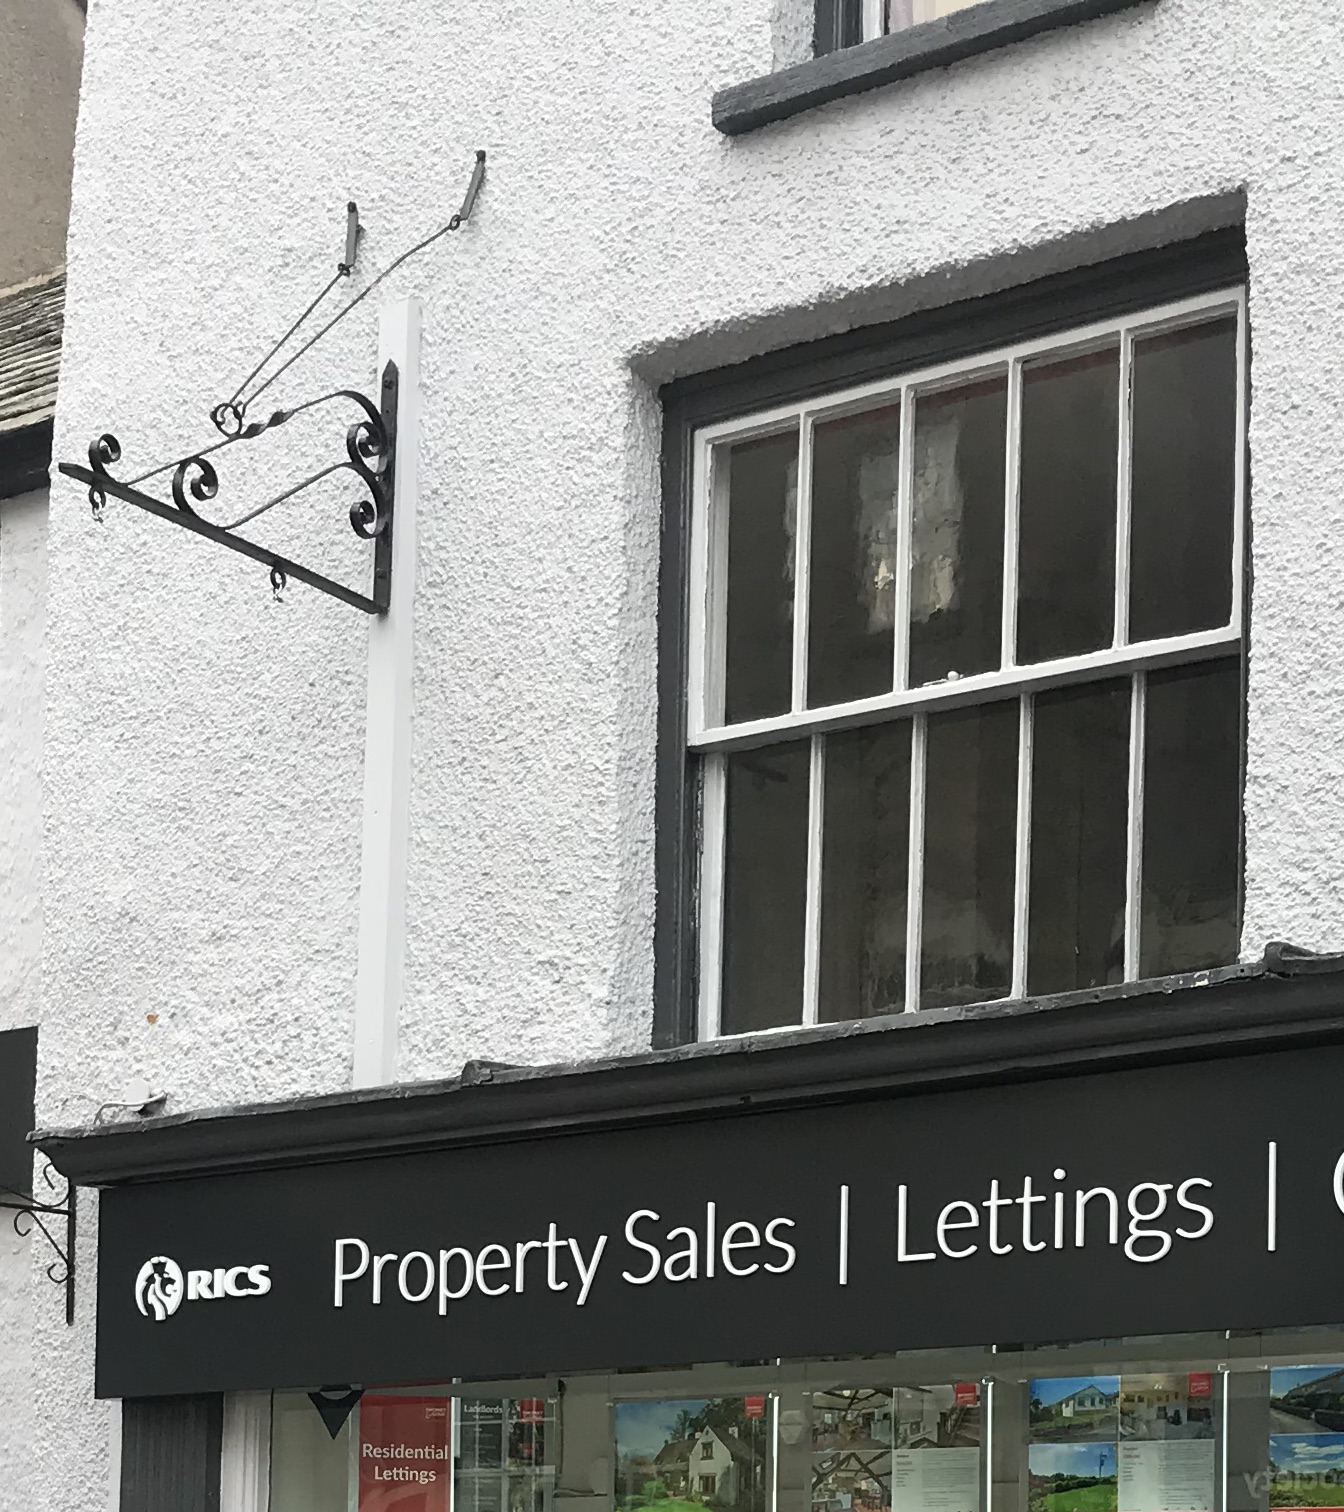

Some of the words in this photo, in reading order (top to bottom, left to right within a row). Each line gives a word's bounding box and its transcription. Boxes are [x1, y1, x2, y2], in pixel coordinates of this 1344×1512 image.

[187, 1264, 272, 1300] RICS
[334, 1222, 608, 1316] Property
[621, 1201, 796, 1284] Sales
[897, 1168, 1214, 1263] Lettings
[362, 1443, 448, 1460] Residential
[374, 1465, 436, 1485] Lettings
